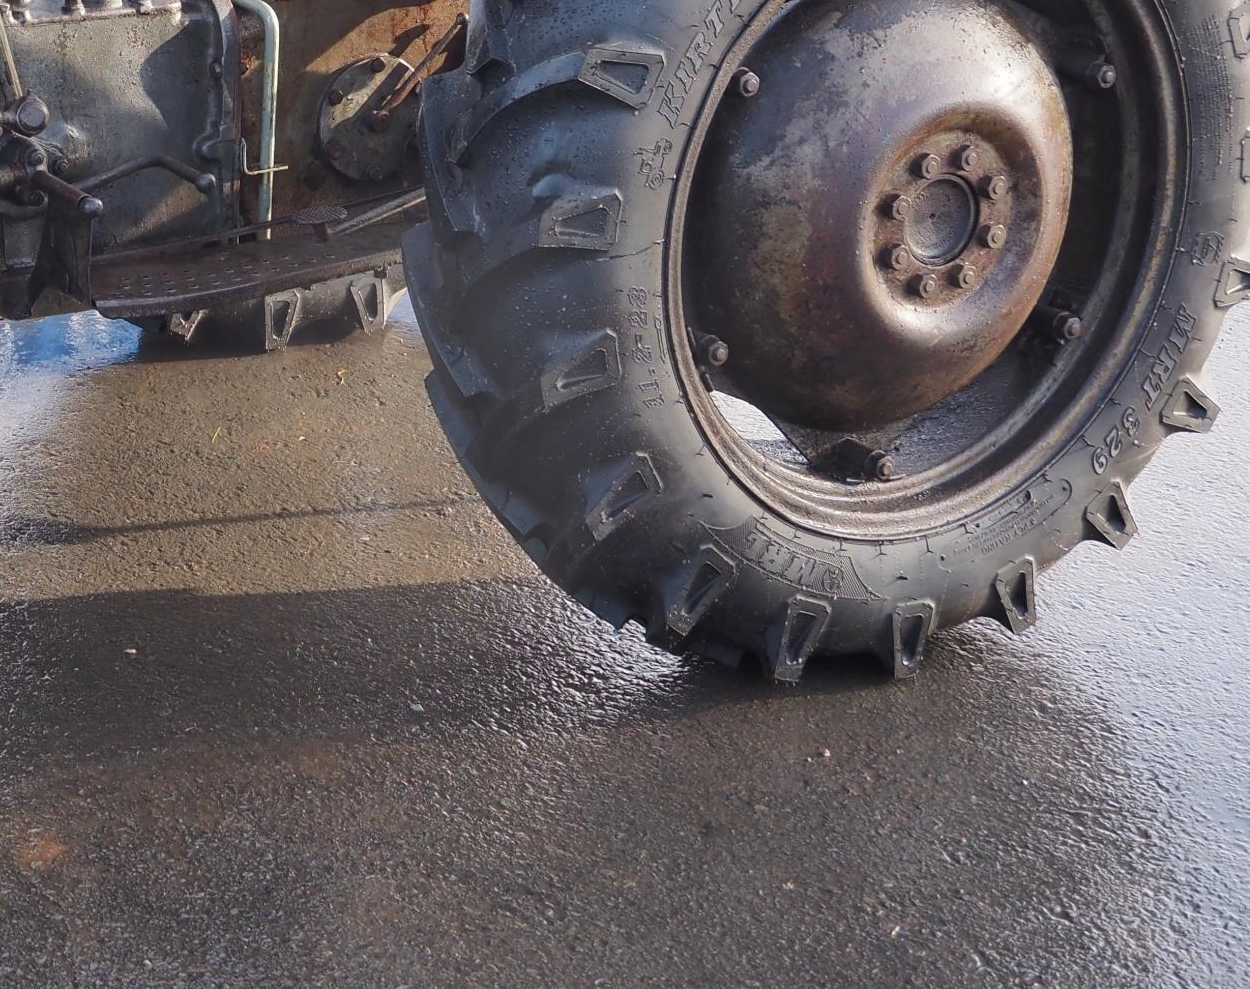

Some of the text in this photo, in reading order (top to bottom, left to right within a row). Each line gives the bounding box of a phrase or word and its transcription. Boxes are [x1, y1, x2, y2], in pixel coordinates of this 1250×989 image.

[1092, 302, 1196, 475] MRT 329
[744, 534, 818, 588] MRL
